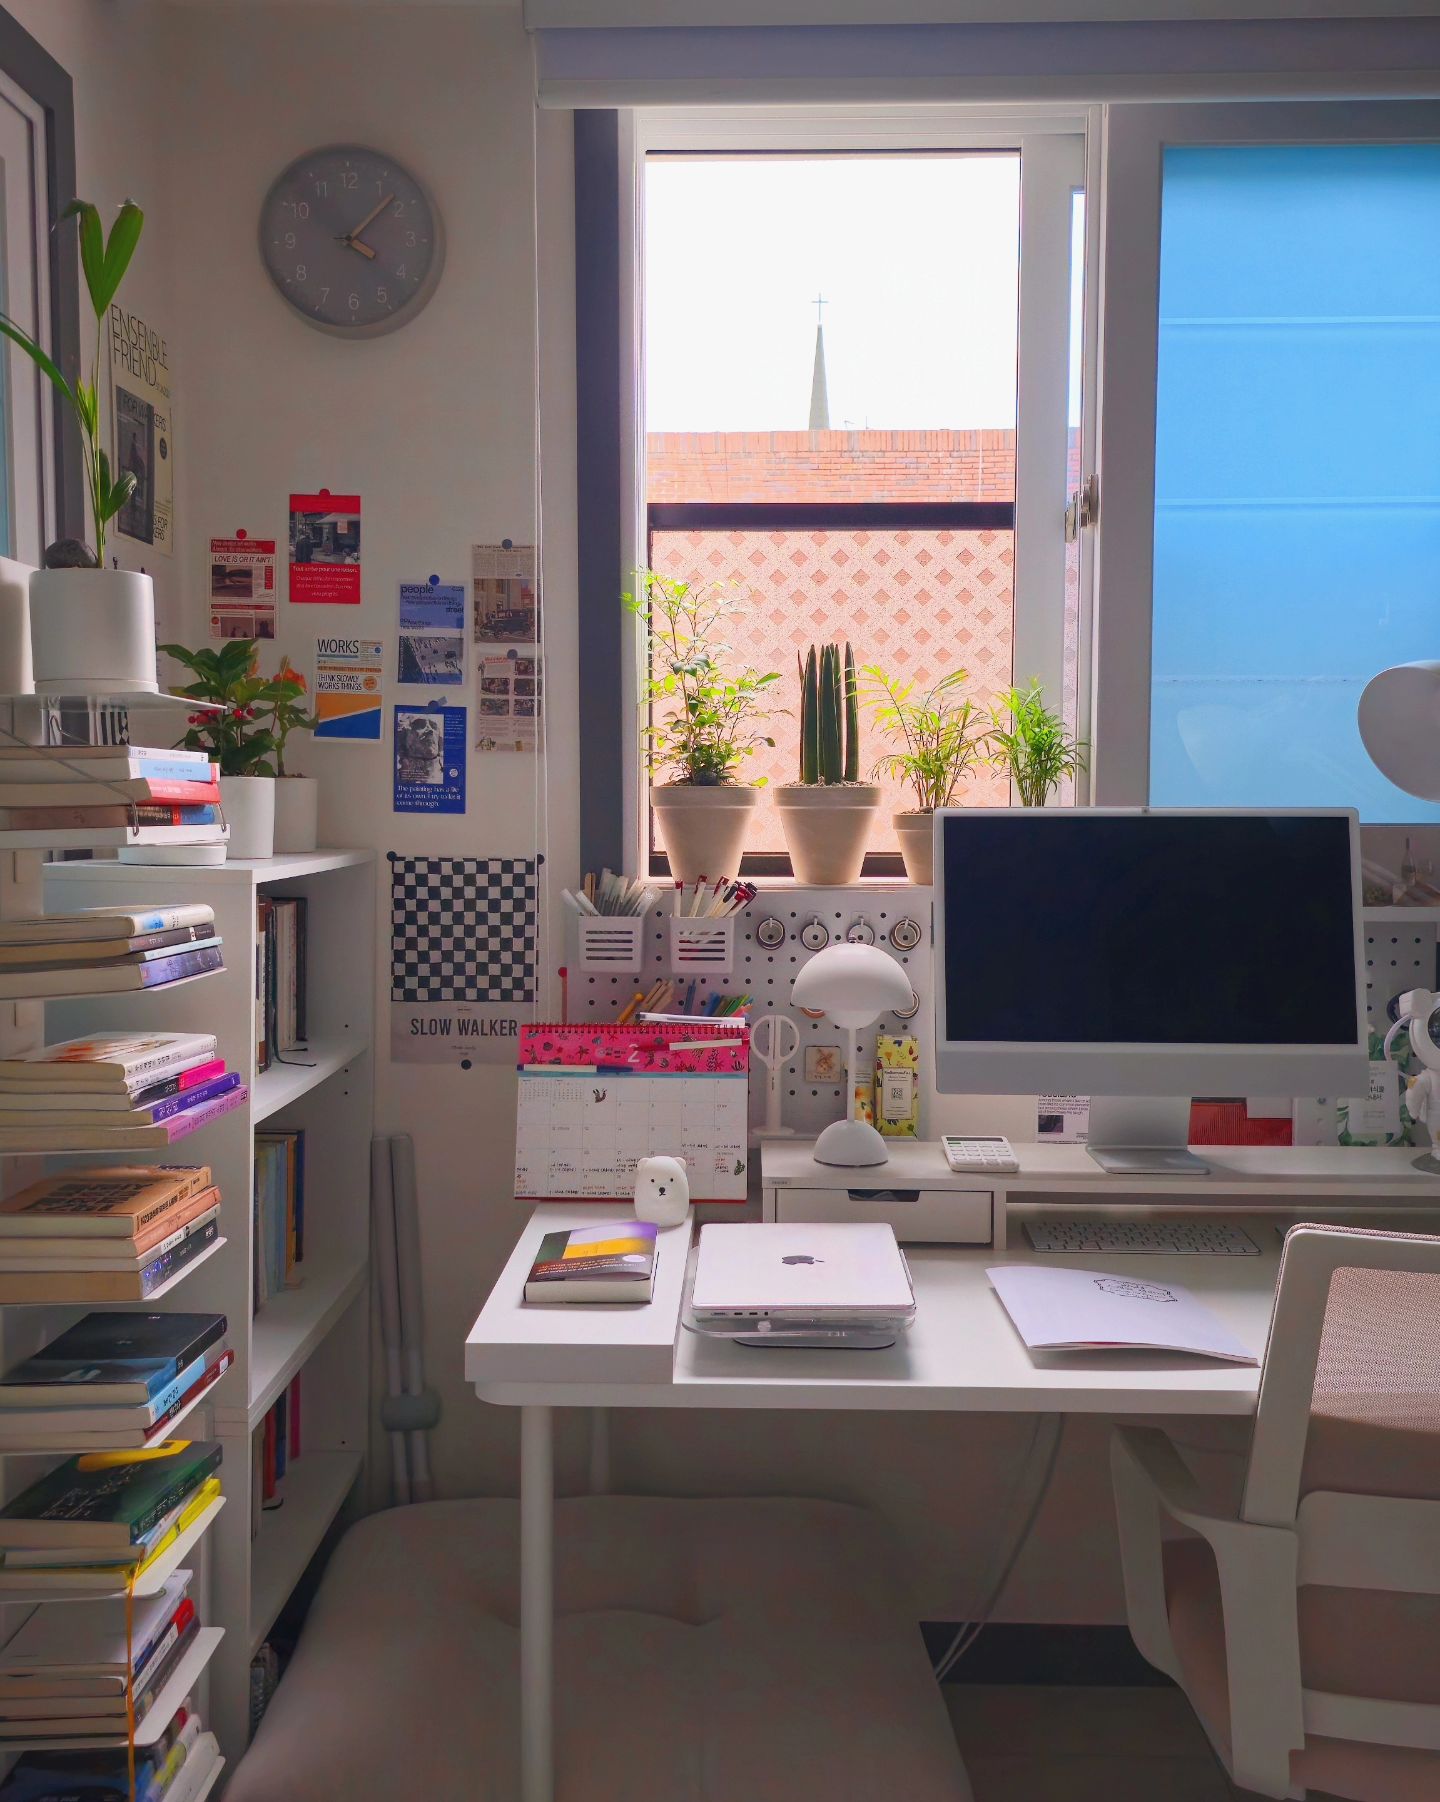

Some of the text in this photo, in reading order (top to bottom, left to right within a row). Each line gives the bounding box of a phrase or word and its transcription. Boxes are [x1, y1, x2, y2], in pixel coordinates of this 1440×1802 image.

[342, 172, 359, 189] 12
[376, 181, 383, 197] 1
[315, 181, 328, 198] 11
[292, 202, 309, 219] 10
[394, 201, 405, 218] 2
[284, 232, 296, 249] 9
[405, 231, 416, 248] 3
[296, 264, 307, 281] 8
[396, 263, 406, 280] 4
[320, 287, 330, 304] 7
[348, 293, 359, 311] 6
[377, 286, 387, 303] 5
[113, 334, 157, 387] FRIEND
[214, 555, 231, 563] LOVE
[232, 555, 238, 563] IS
[239, 555, 249, 563] OR
[401, 583, 434, 598] people
[317, 638, 359, 654] WORKS
[318, 673, 360, 683] THINK SLOWLY
[318, 682, 362, 691] WORKS THINGS
[410, 1018, 518, 1037] SLOW WALKER
[627, 1043, 641, 1063] 2
